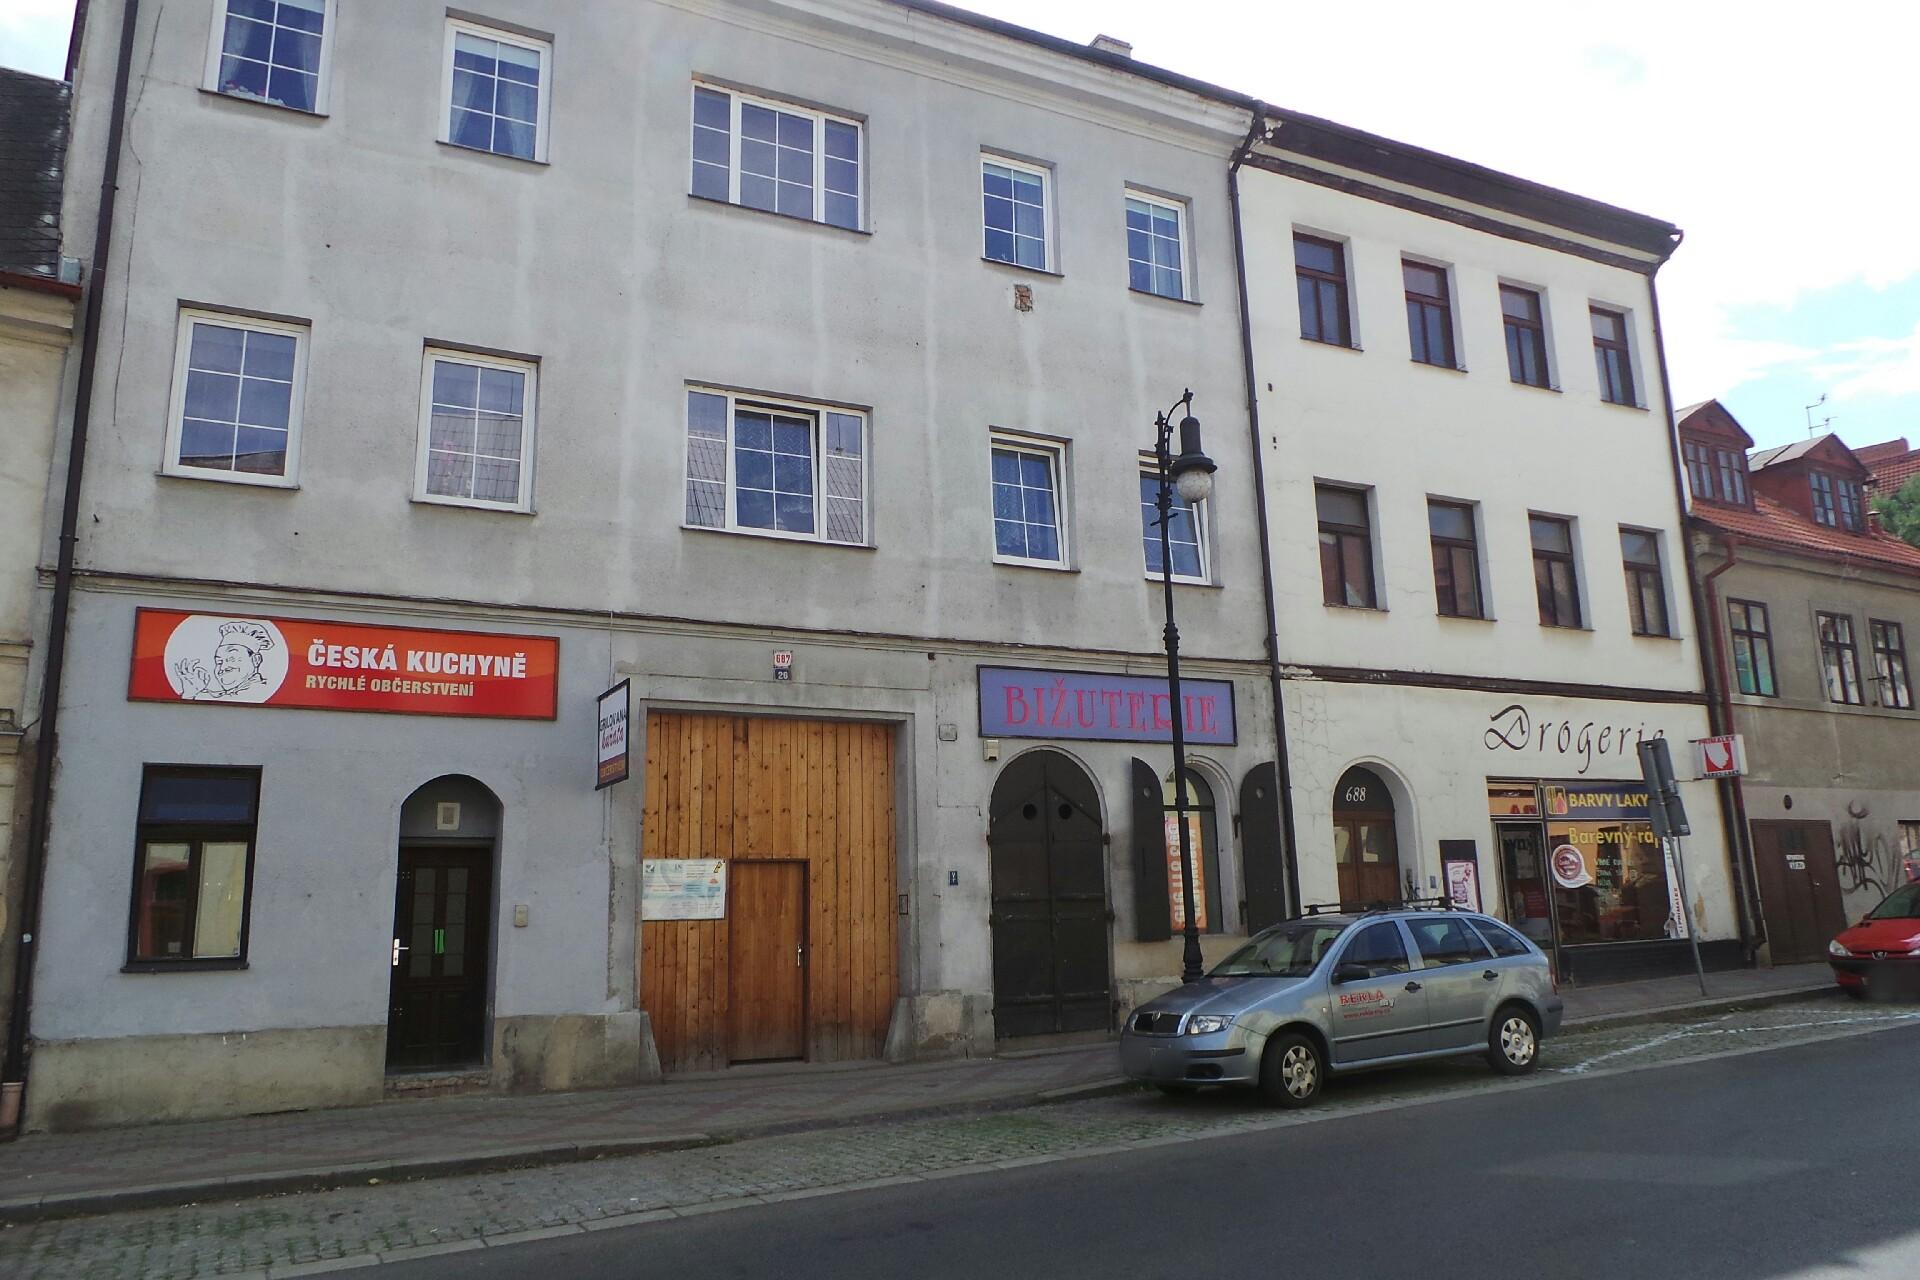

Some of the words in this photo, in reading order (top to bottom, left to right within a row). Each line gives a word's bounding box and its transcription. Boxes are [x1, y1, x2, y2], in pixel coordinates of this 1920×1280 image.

[307, 639, 398, 671] ČESKÁ
[406, 650, 527, 679] KUCHYNĚ
[305, 674, 366, 692] RYCHLÉ
[370, 677, 475, 698] OBČERSTVENÍ
[1002, 678, 1217, 735] BIŽUTERIE
[1346, 786, 1366, 802] 688
[1568, 793, 1614, 808] BARVY
[1616, 793, 1650, 807] LAKY
[1569, 825, 1632, 848] Barevný
